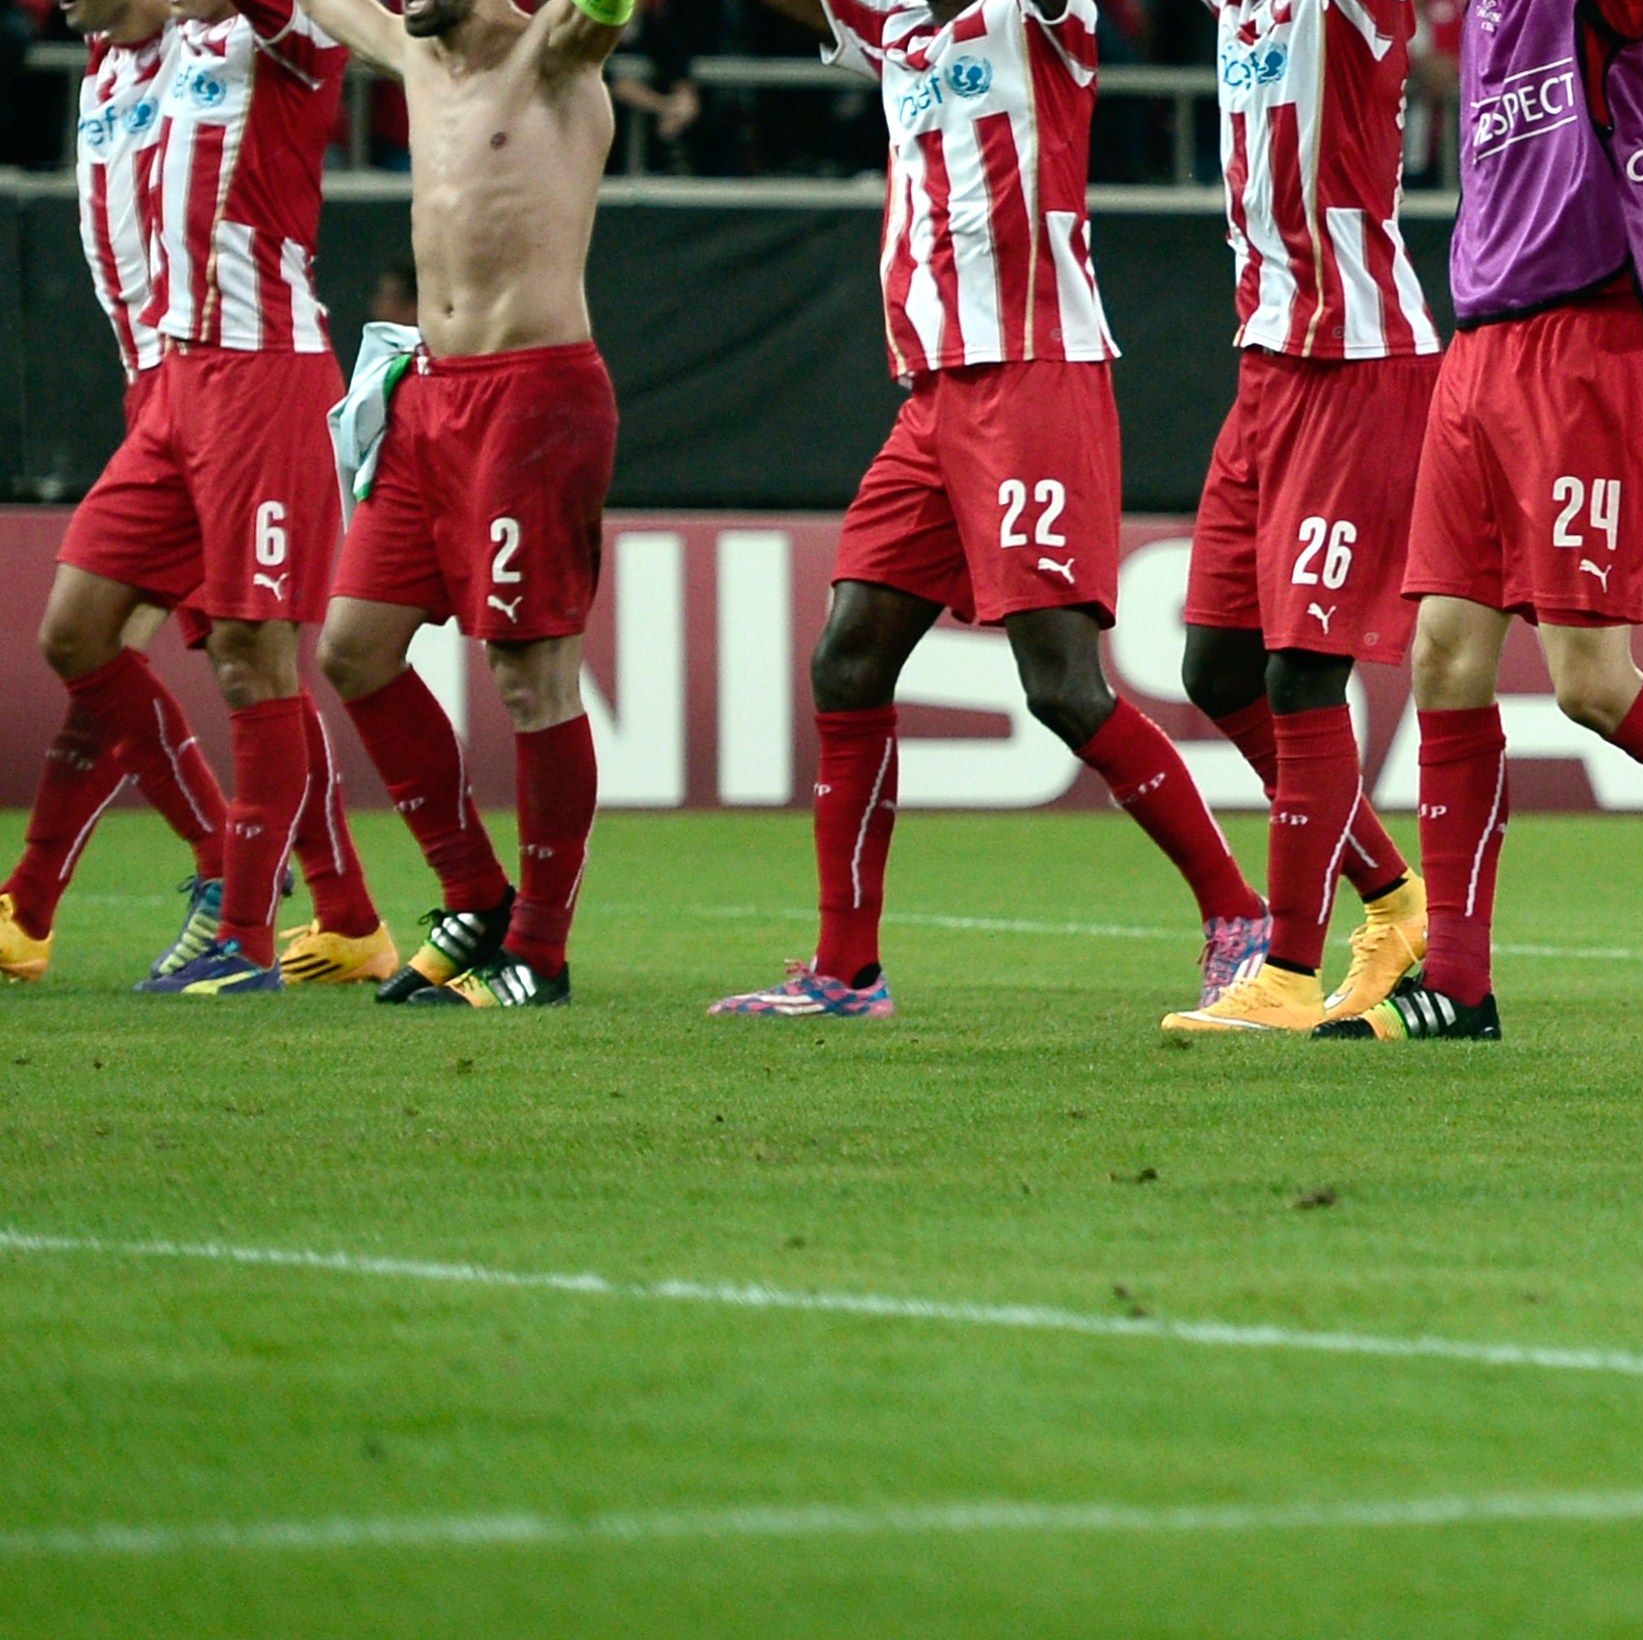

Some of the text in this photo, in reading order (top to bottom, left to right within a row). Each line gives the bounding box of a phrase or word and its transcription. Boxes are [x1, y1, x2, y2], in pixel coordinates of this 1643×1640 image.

[255, 500, 286, 566] 6
[998, 478, 1066, 549] 22
[1552, 476, 1621, 550] 24
[490, 517, 521, 583] 2
[1291, 516, 1357, 590] 26
